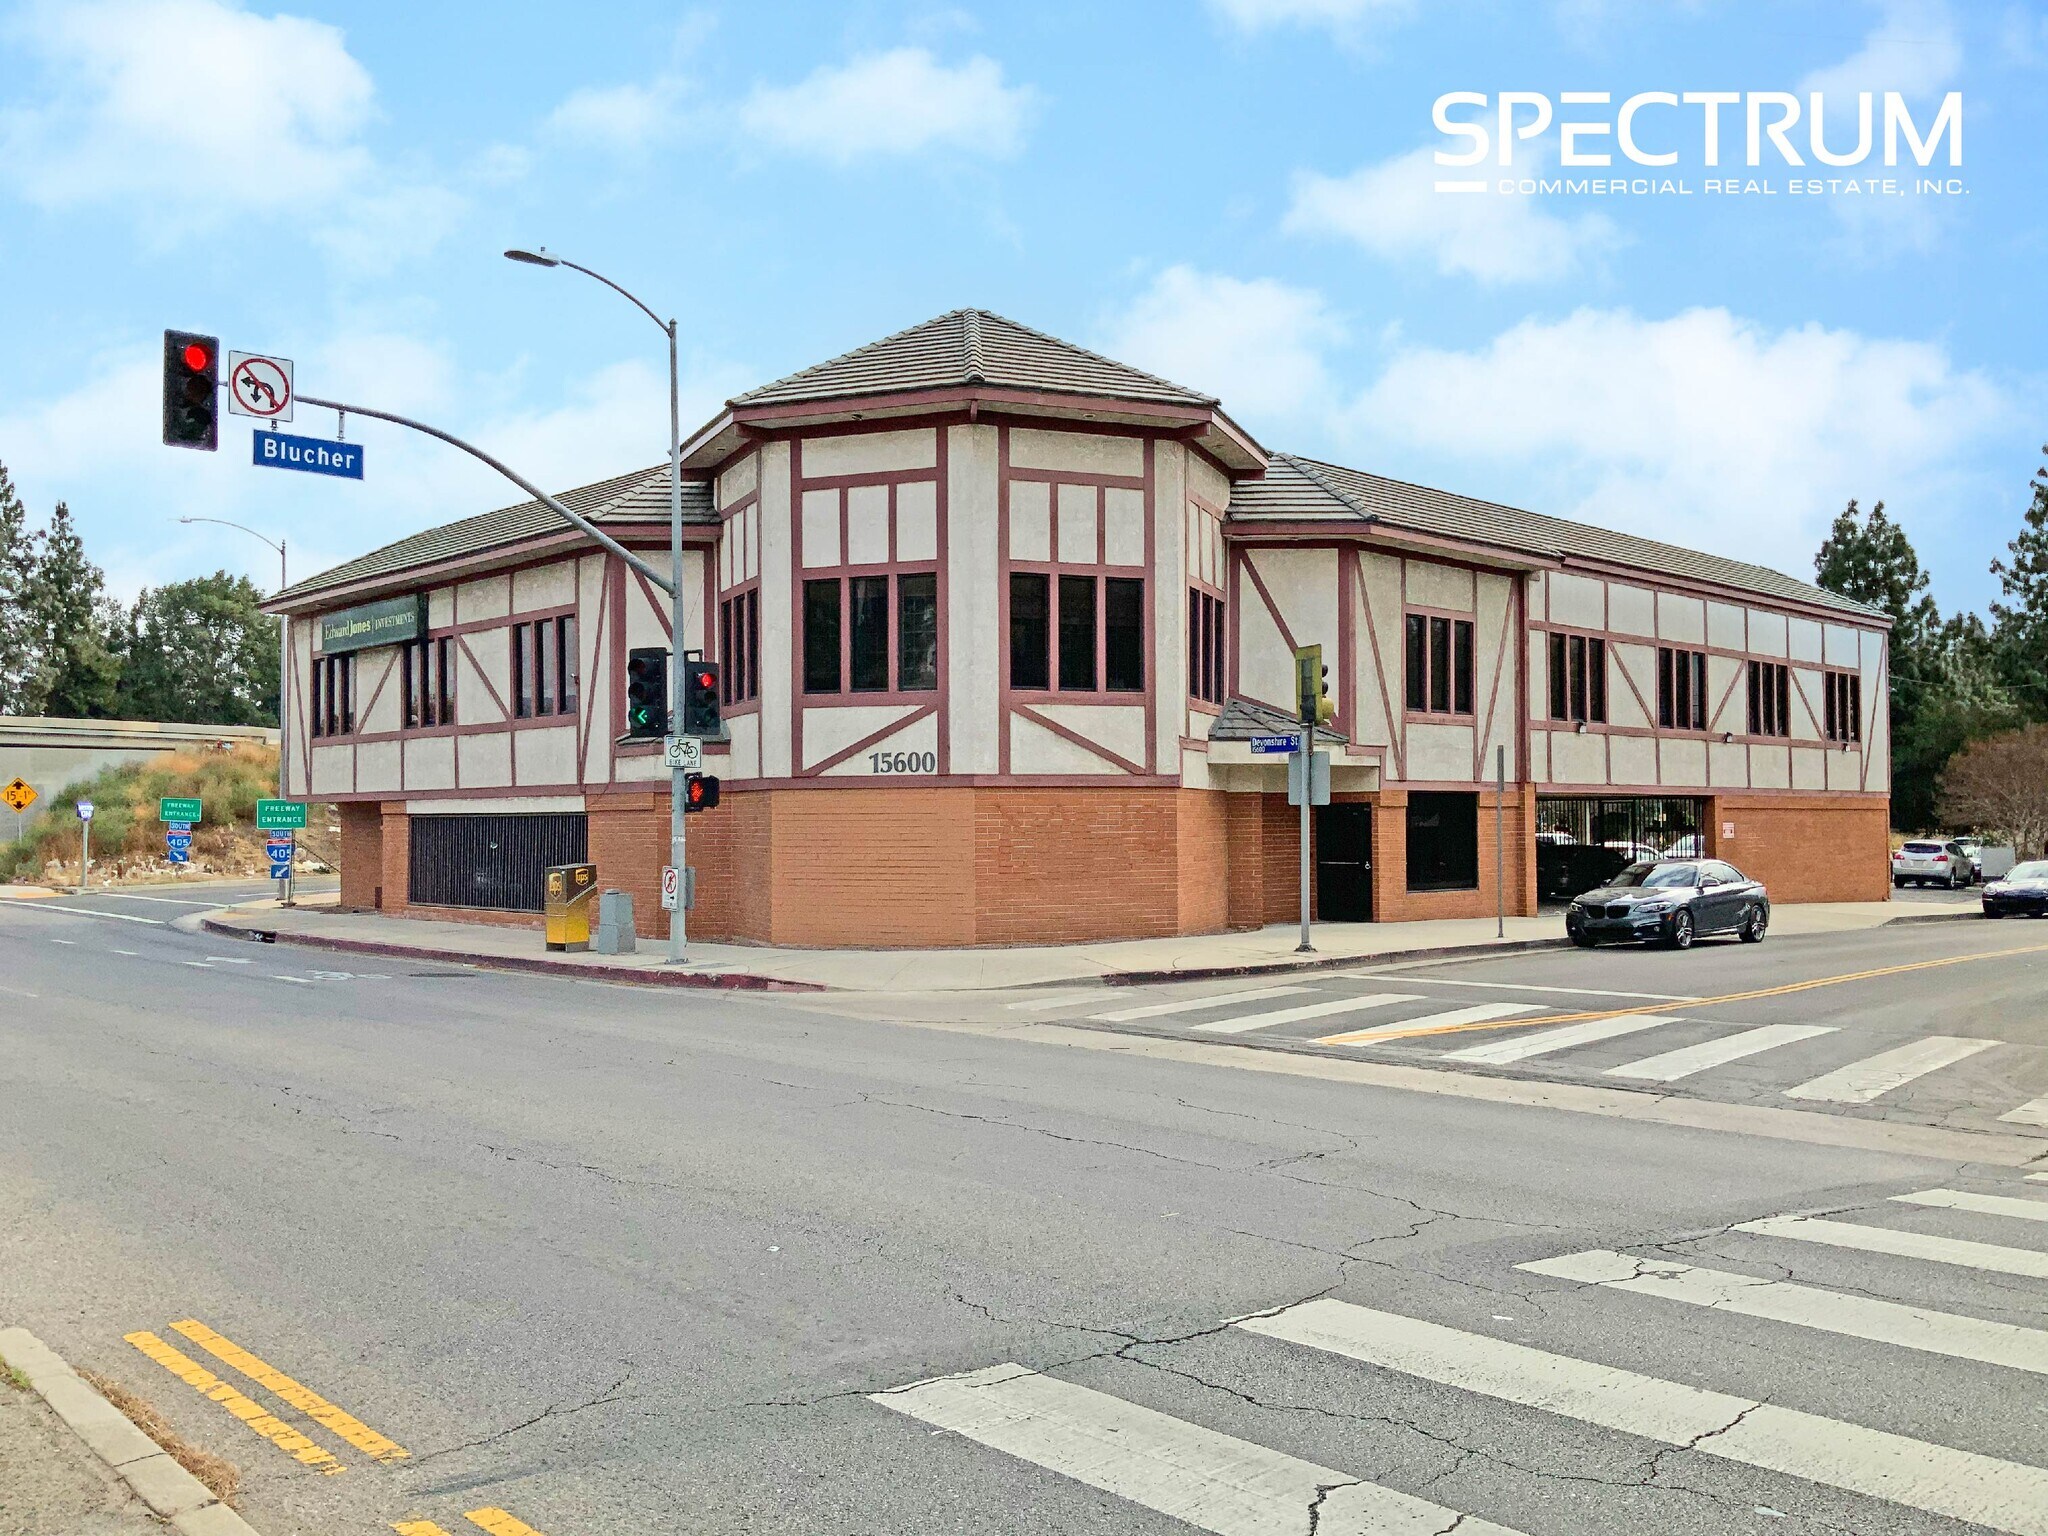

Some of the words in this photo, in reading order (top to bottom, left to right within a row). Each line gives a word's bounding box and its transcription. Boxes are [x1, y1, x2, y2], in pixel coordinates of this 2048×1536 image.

[264, 438, 355, 469] Blucher
[1252, 737, 1287, 746] Devonshire
[1290, 736, 1299, 746] St
[868, 752, 936, 773] 15600
[170, 838, 189, 846] 405
[576, 873, 589, 883] ups
